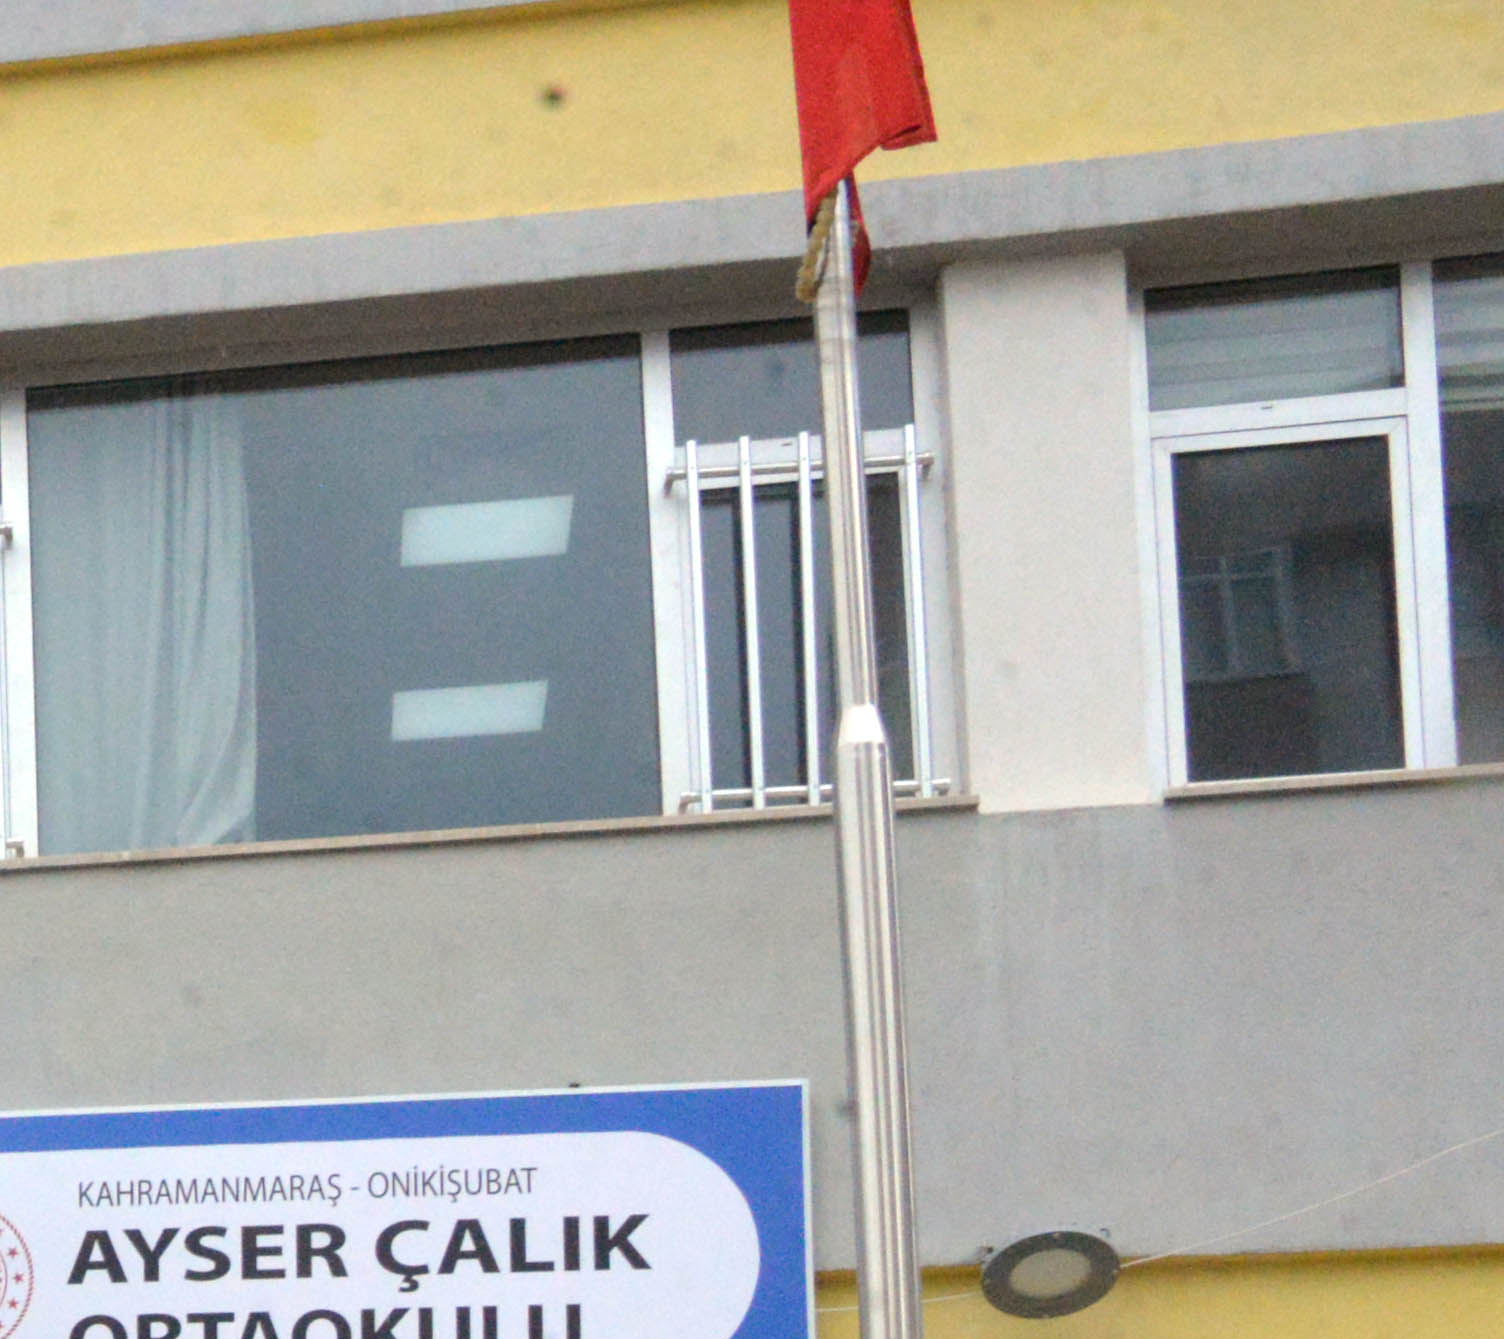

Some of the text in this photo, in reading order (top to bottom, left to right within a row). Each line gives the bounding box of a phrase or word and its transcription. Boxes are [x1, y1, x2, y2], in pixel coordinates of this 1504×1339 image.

[79, 1174, 342, 1207] KAHRAMANMARAŞ
[368, 1165, 537, 1198] ONİKİŞUBAT
[67, 1213, 652, 1293] AYSER ÇALIK
